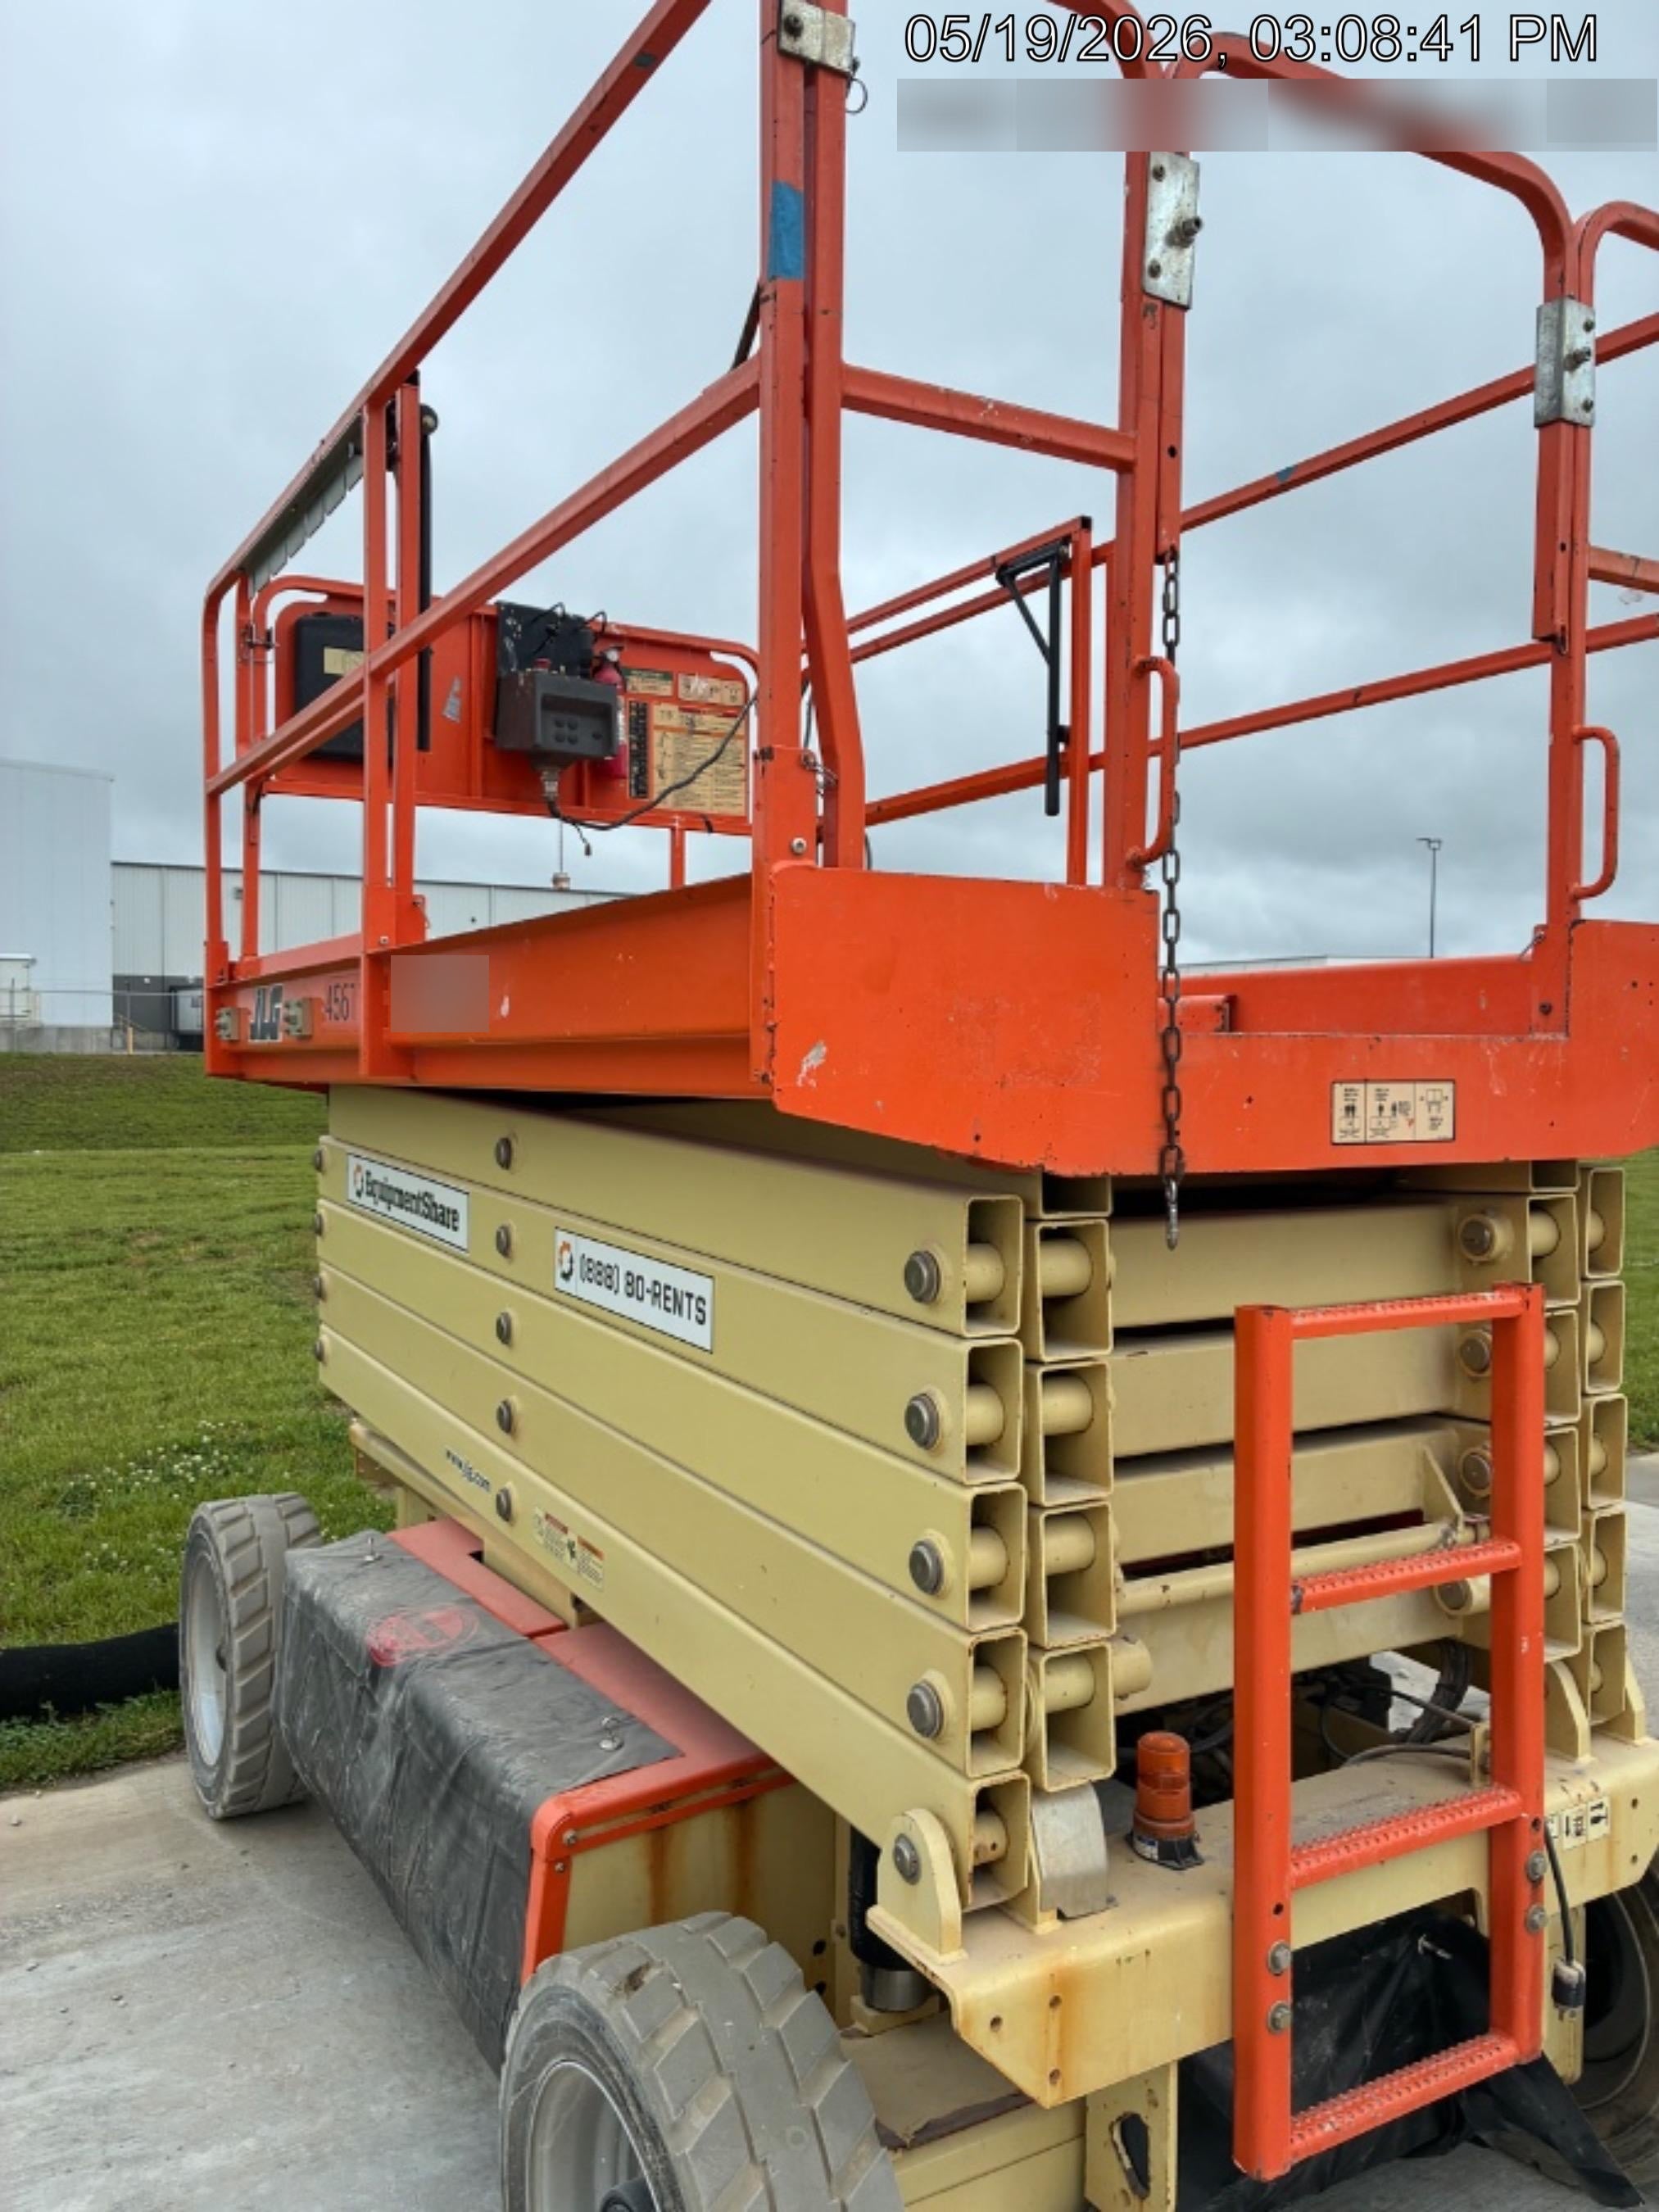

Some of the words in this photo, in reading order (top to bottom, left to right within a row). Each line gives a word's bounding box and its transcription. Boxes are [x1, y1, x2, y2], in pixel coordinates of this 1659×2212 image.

[249, 983, 283, 1041] JLG
[365, 1169, 460, 1232] EquipmentShare
[579, 1253, 620, 1295] (888)
[624, 1270, 707, 1326] 80-RENTS
